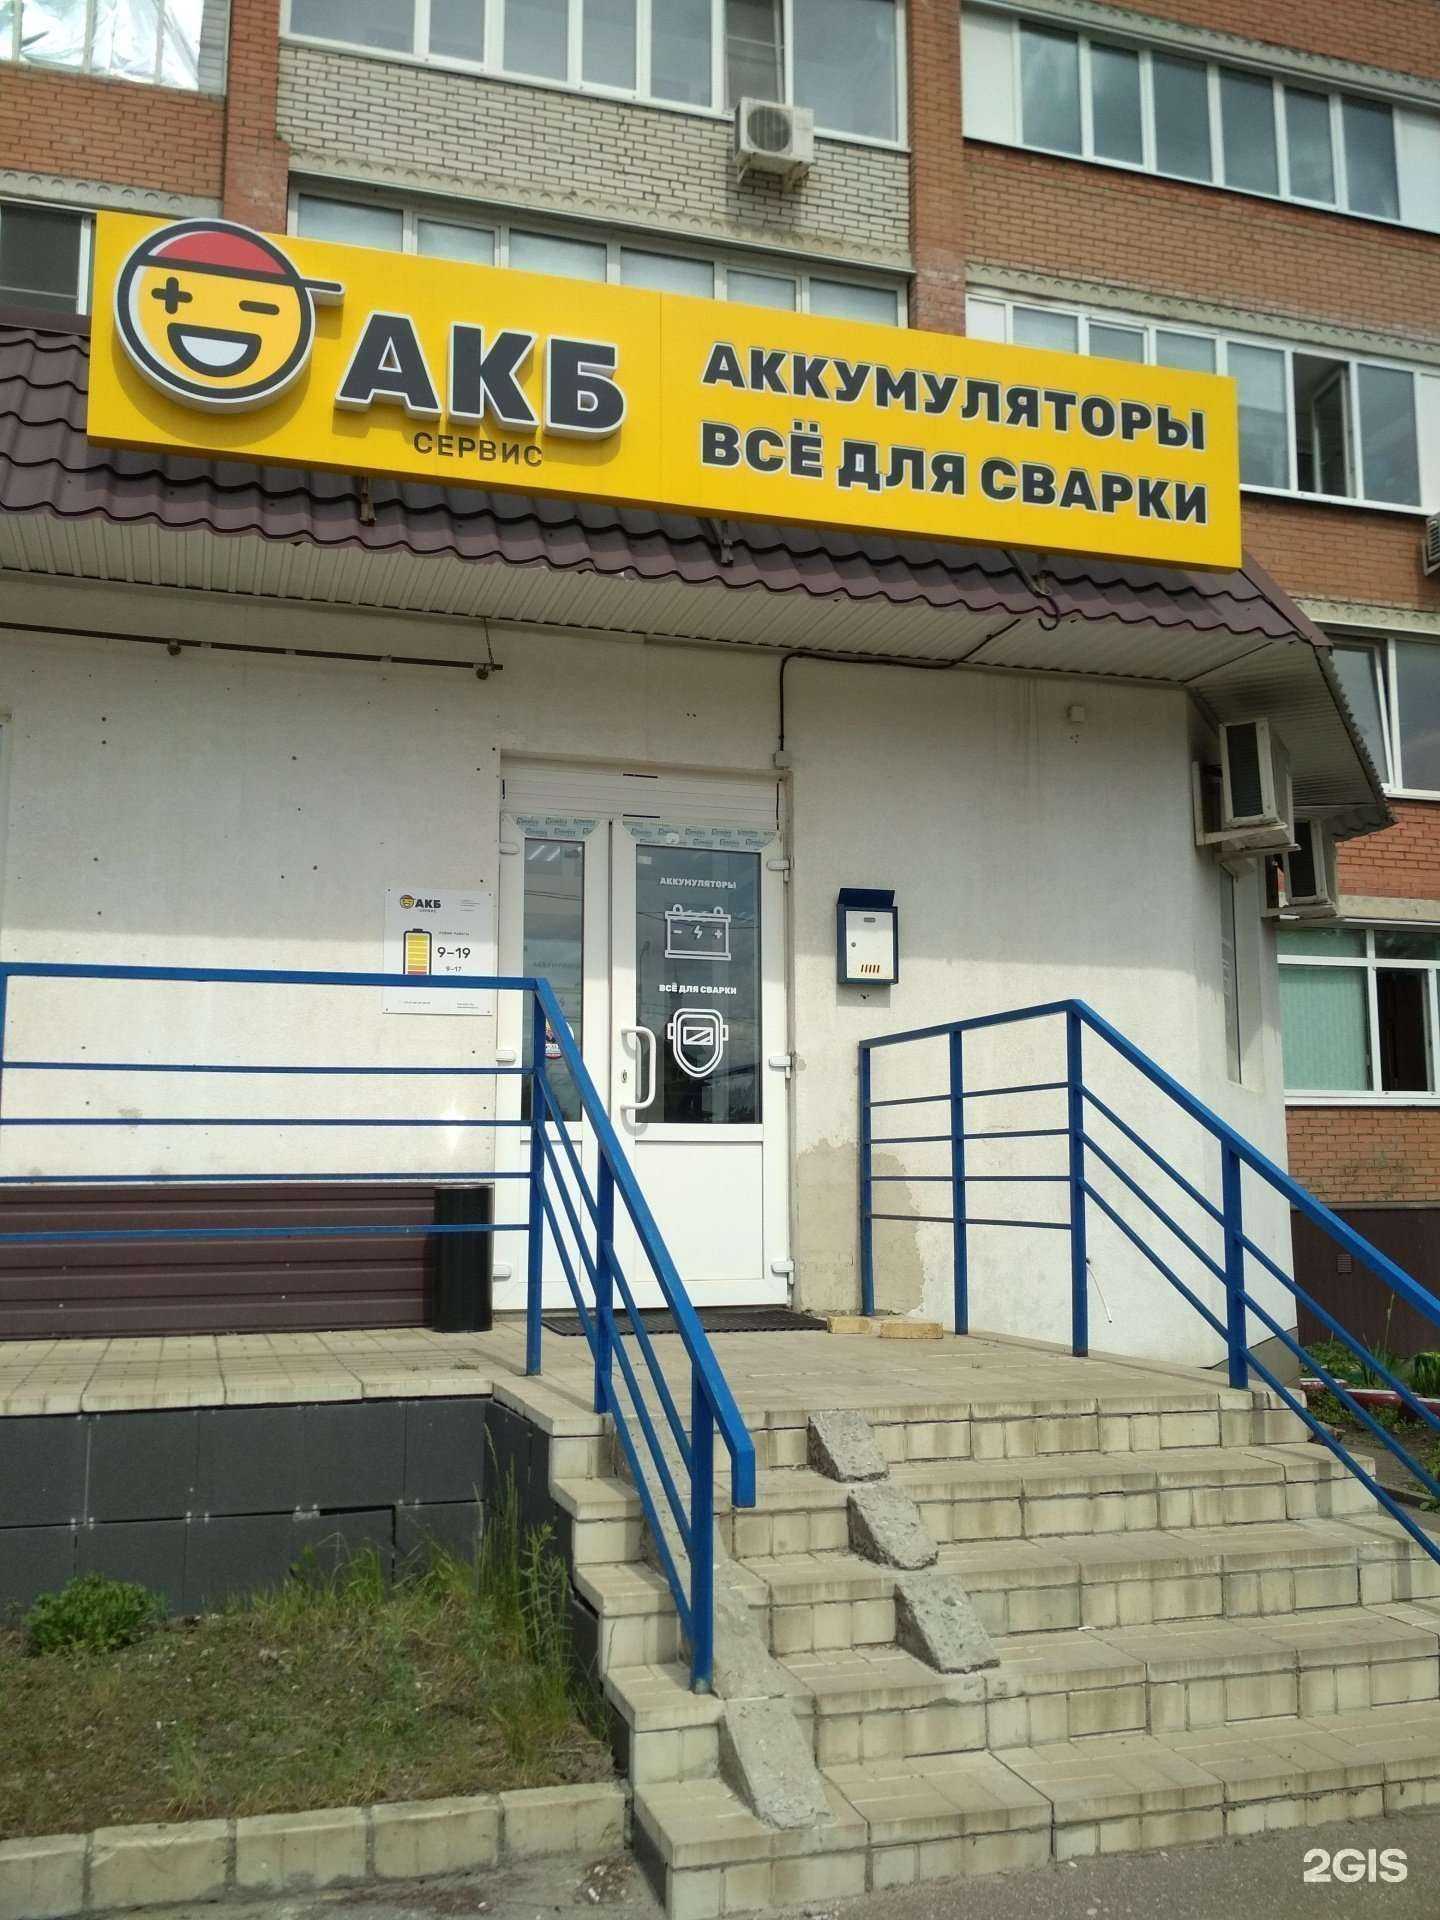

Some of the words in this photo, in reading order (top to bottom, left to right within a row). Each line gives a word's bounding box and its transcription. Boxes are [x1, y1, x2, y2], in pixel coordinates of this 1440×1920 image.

[335, 311, 626, 438] АКБ
[701, 342, 1206, 451] АККУМУЛЯТОРЫ
[413, 432, 543, 467] СЕРВИС
[700, 419, 824, 479] ВСЁ
[837, 439, 967, 497] ДЛЯ
[981, 456, 1208, 525] СВАРКИ
[414, 899, 442, 909] АКБ
[659, 982, 678, 993] ВСЁ
[679, 985, 699, 994] ДЛЯ
[700, 986, 737, 995] СВАРКИ
